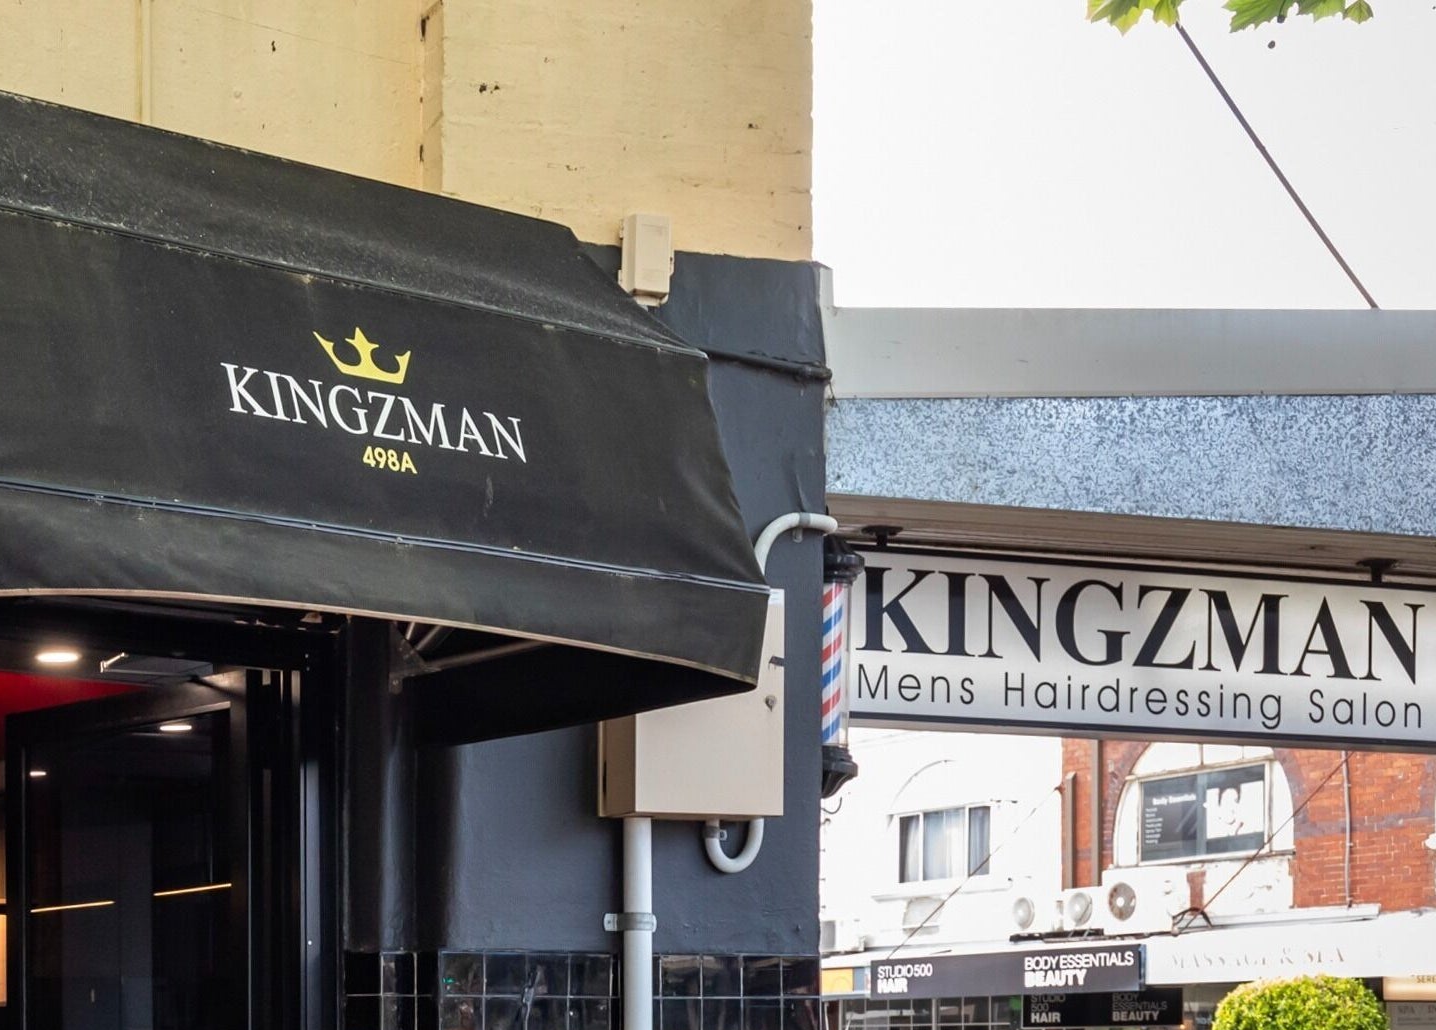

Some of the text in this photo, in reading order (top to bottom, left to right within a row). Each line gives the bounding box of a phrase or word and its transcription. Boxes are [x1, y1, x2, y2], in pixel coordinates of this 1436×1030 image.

[220, 362, 528, 464] KINGZMAN
[362, 445, 418, 475] 498A
[855, 565, 1426, 686] KINGZMAN
[856, 663, 1424, 731] Mens Hairdressing Salon
[1024, 950, 1134, 971] BODY ESSENTIALS
[876, 977, 908, 994] HAIR
[1024, 968, 1087, 988] BEAUTY
[1030, 1002, 1049, 1012] 500
[1030, 1011, 1062, 1023] HAIR
[1112, 1010, 1160, 1022] BEAUTY
